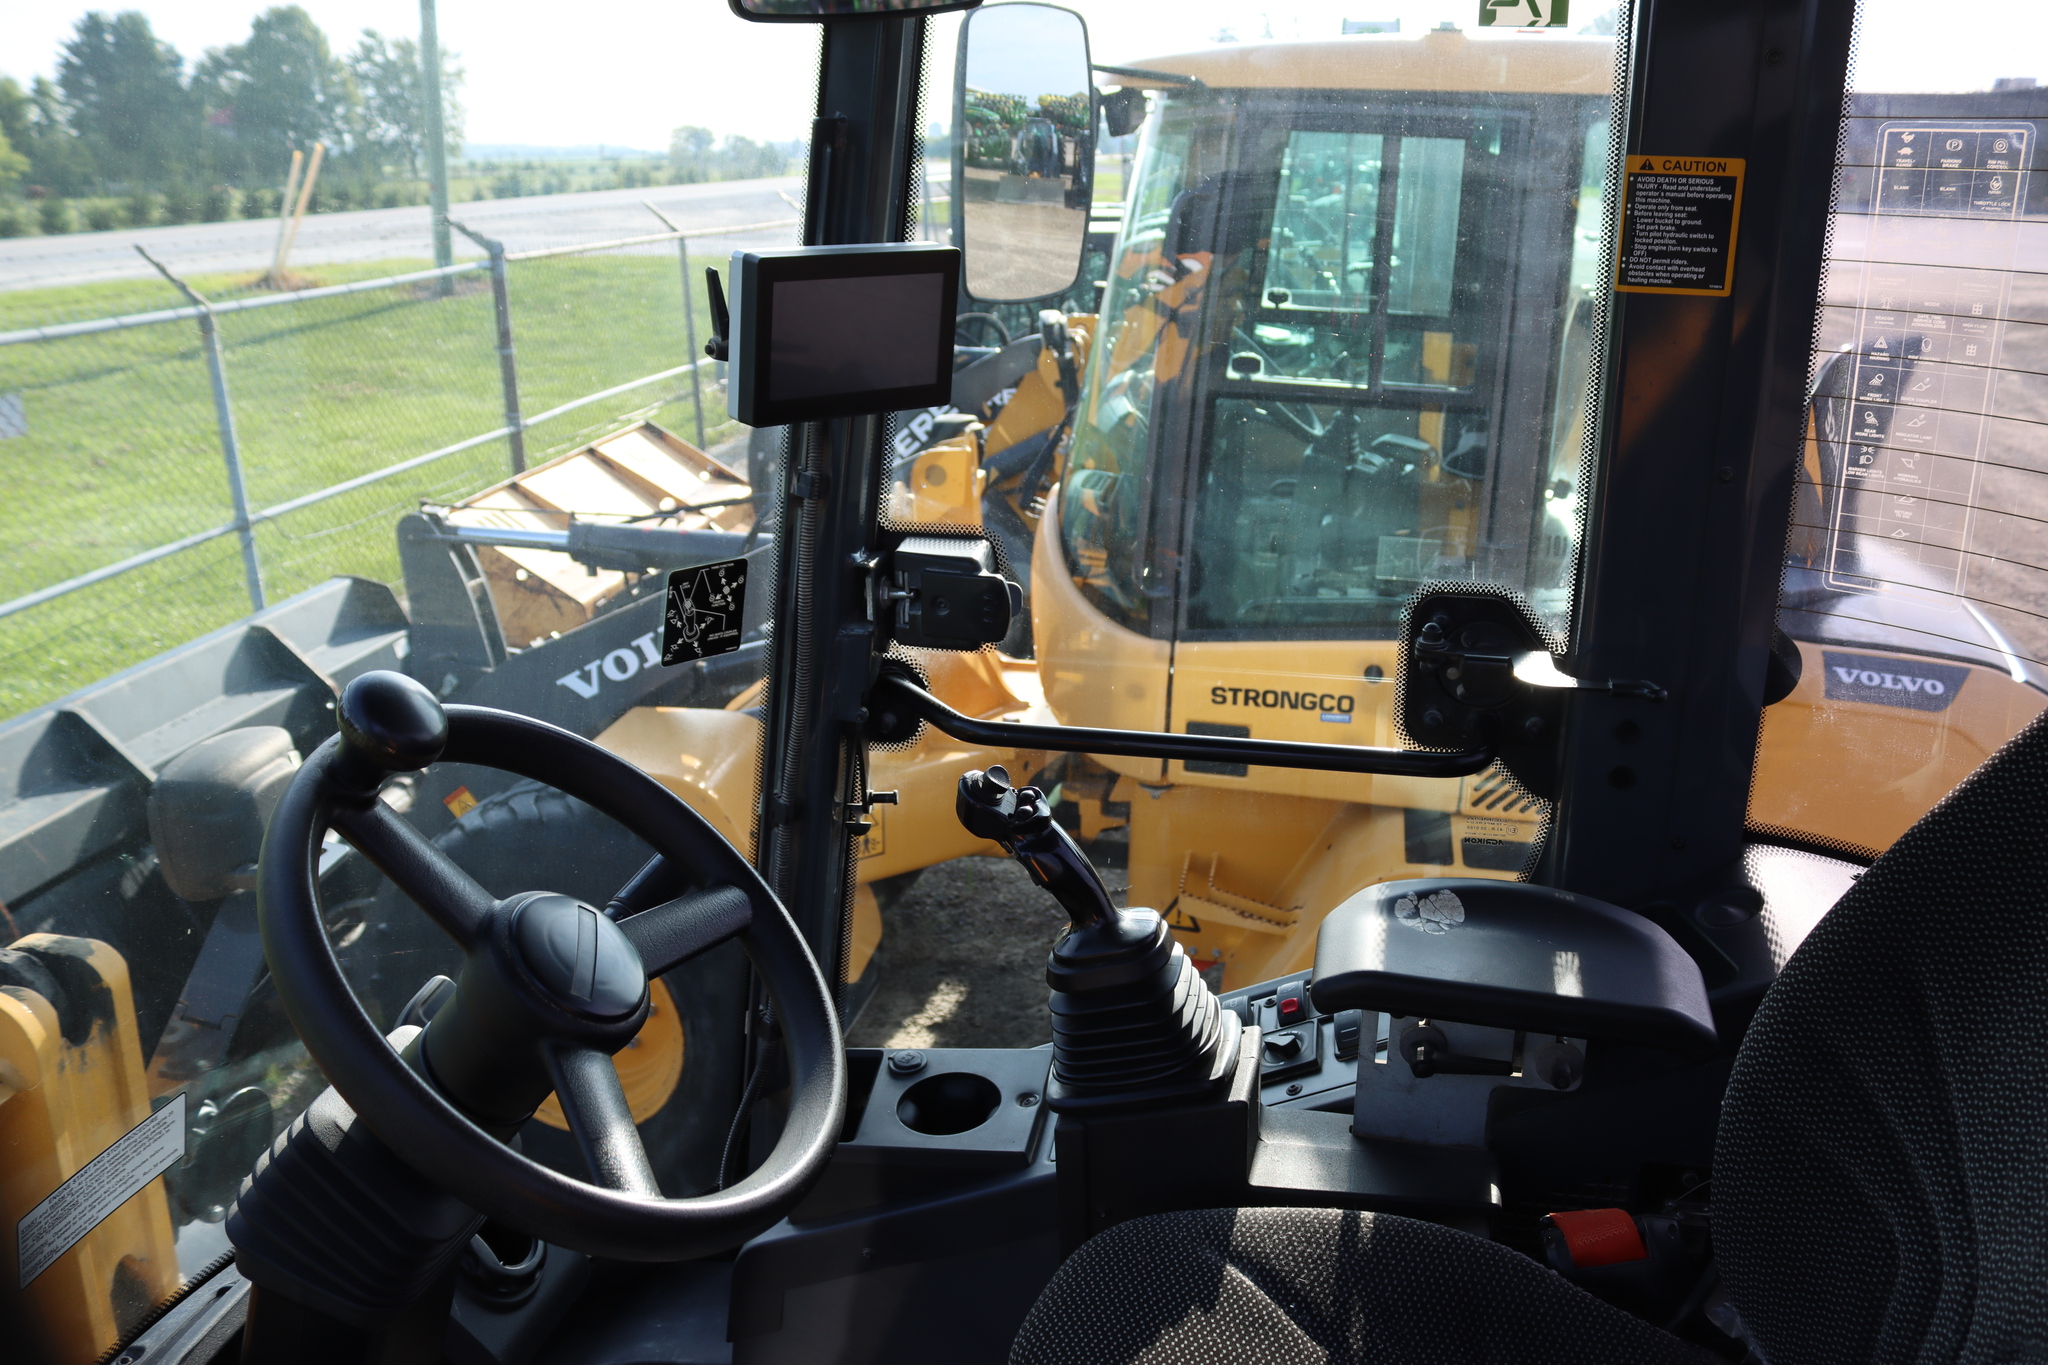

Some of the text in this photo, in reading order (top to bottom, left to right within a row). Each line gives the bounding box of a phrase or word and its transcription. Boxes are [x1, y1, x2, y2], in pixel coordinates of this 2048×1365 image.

[1662, 159, 1727, 173] CAUTION
[1893, 476, 1922, 484] HYDRAULICS
[555, 630, 663, 700] VOL
[1833, 666, 1946, 695] VOLVO
[1211, 686, 1356, 713] STRONGCO
